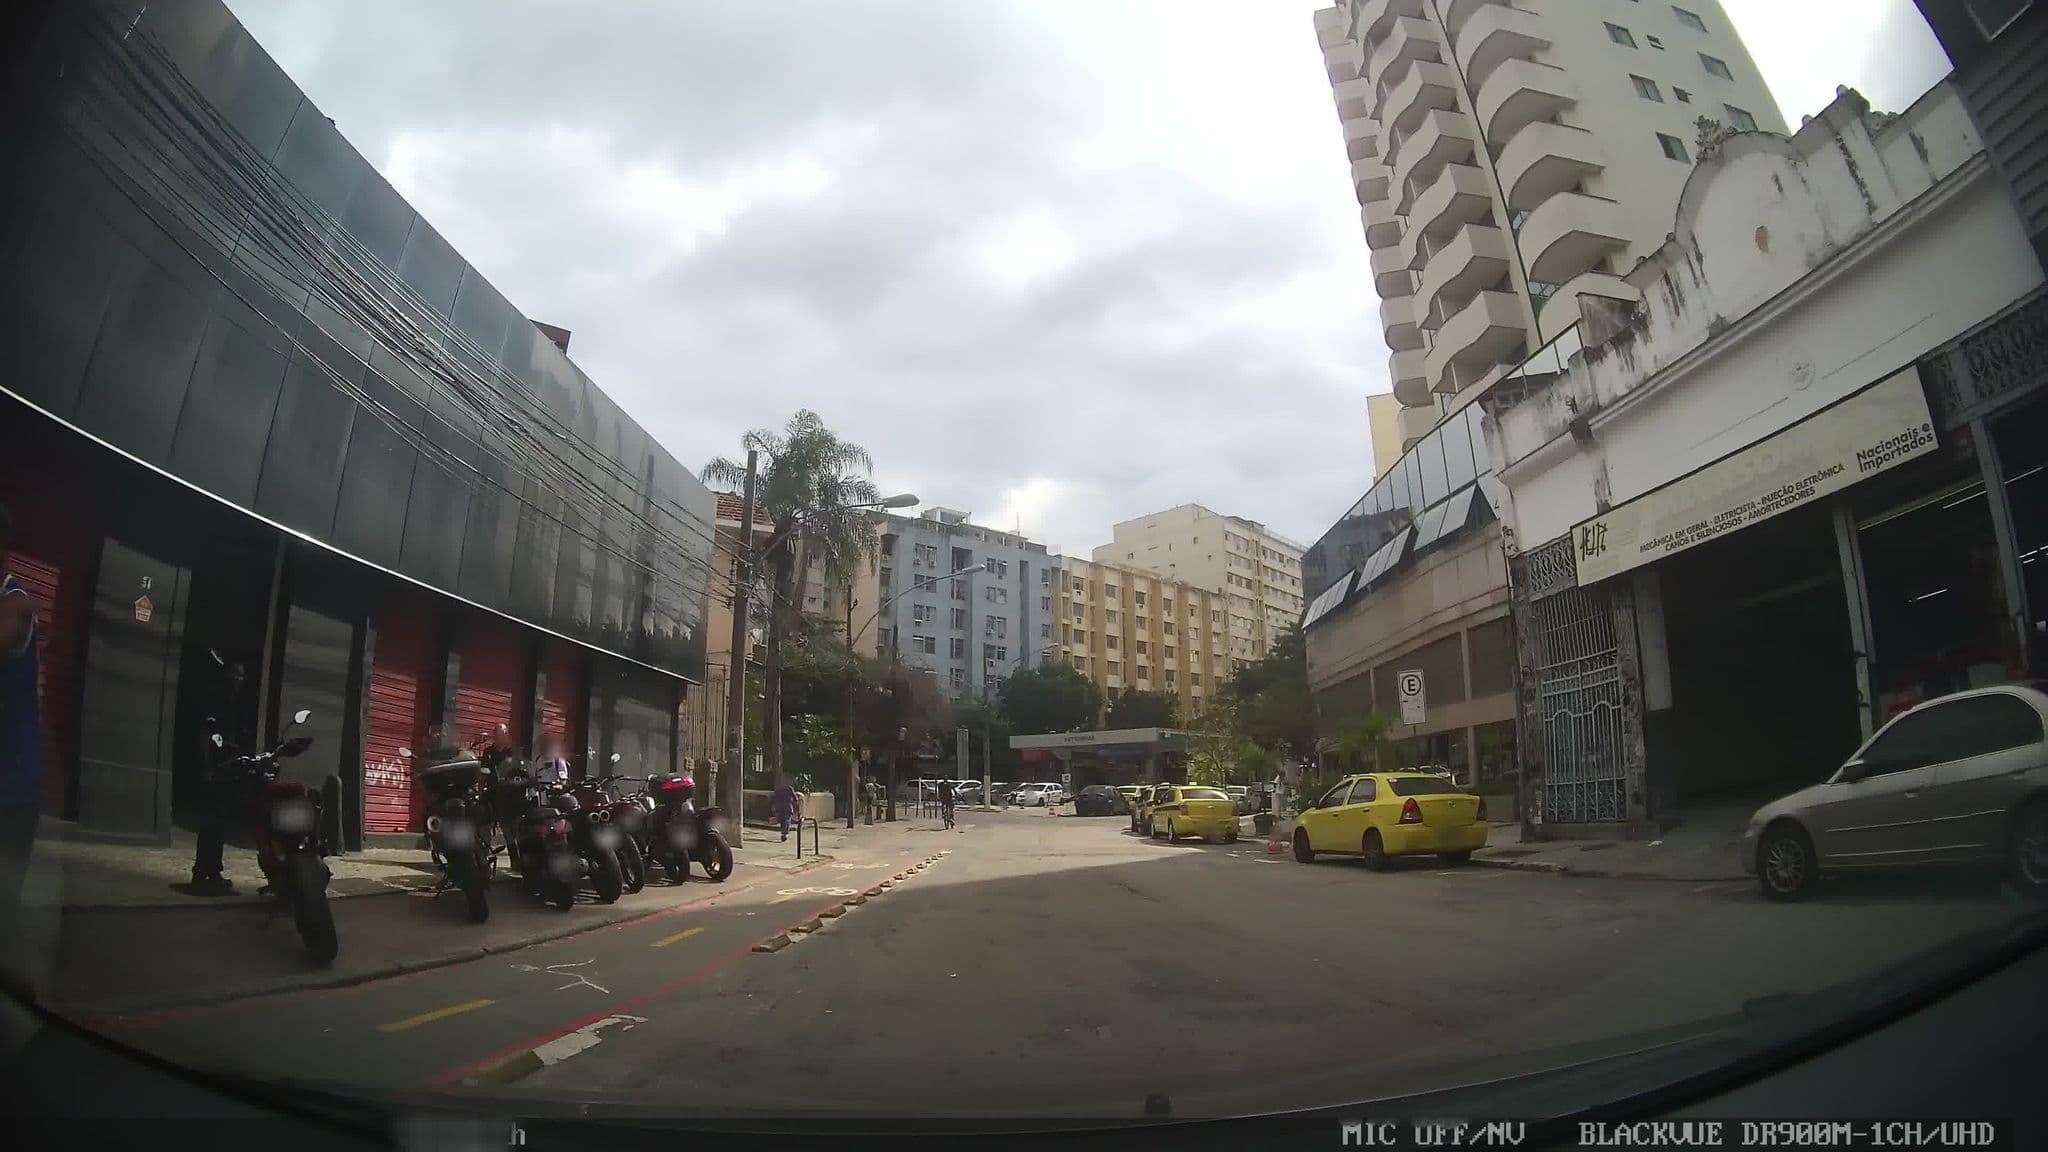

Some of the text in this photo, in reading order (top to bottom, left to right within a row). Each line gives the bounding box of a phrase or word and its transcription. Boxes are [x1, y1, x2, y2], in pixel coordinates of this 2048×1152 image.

[1856, 423, 1930, 460] Nacionais e
[1857, 432, 1934, 473] Importados
[1640, 533, 1674, 552] MECÂNICA
[1675, 529, 1686, 540] EM
[1686, 520, 1708, 535] GERAL
[1714, 501, 1756, 524] ELETRICISTA
[1761, 484, 1794, 505] INJEÇÃO
[1795, 463, 1845, 490] ELETRÔNICA
[1665, 536, 1690, 551] CANOS
[1690, 534, 1696, 542] E
[1696, 515, 1742, 540] SILENCIOSOS
[1748, 486, 1816, 520] AMORTECEDORES
[1407, 679, 1416, 691] E
